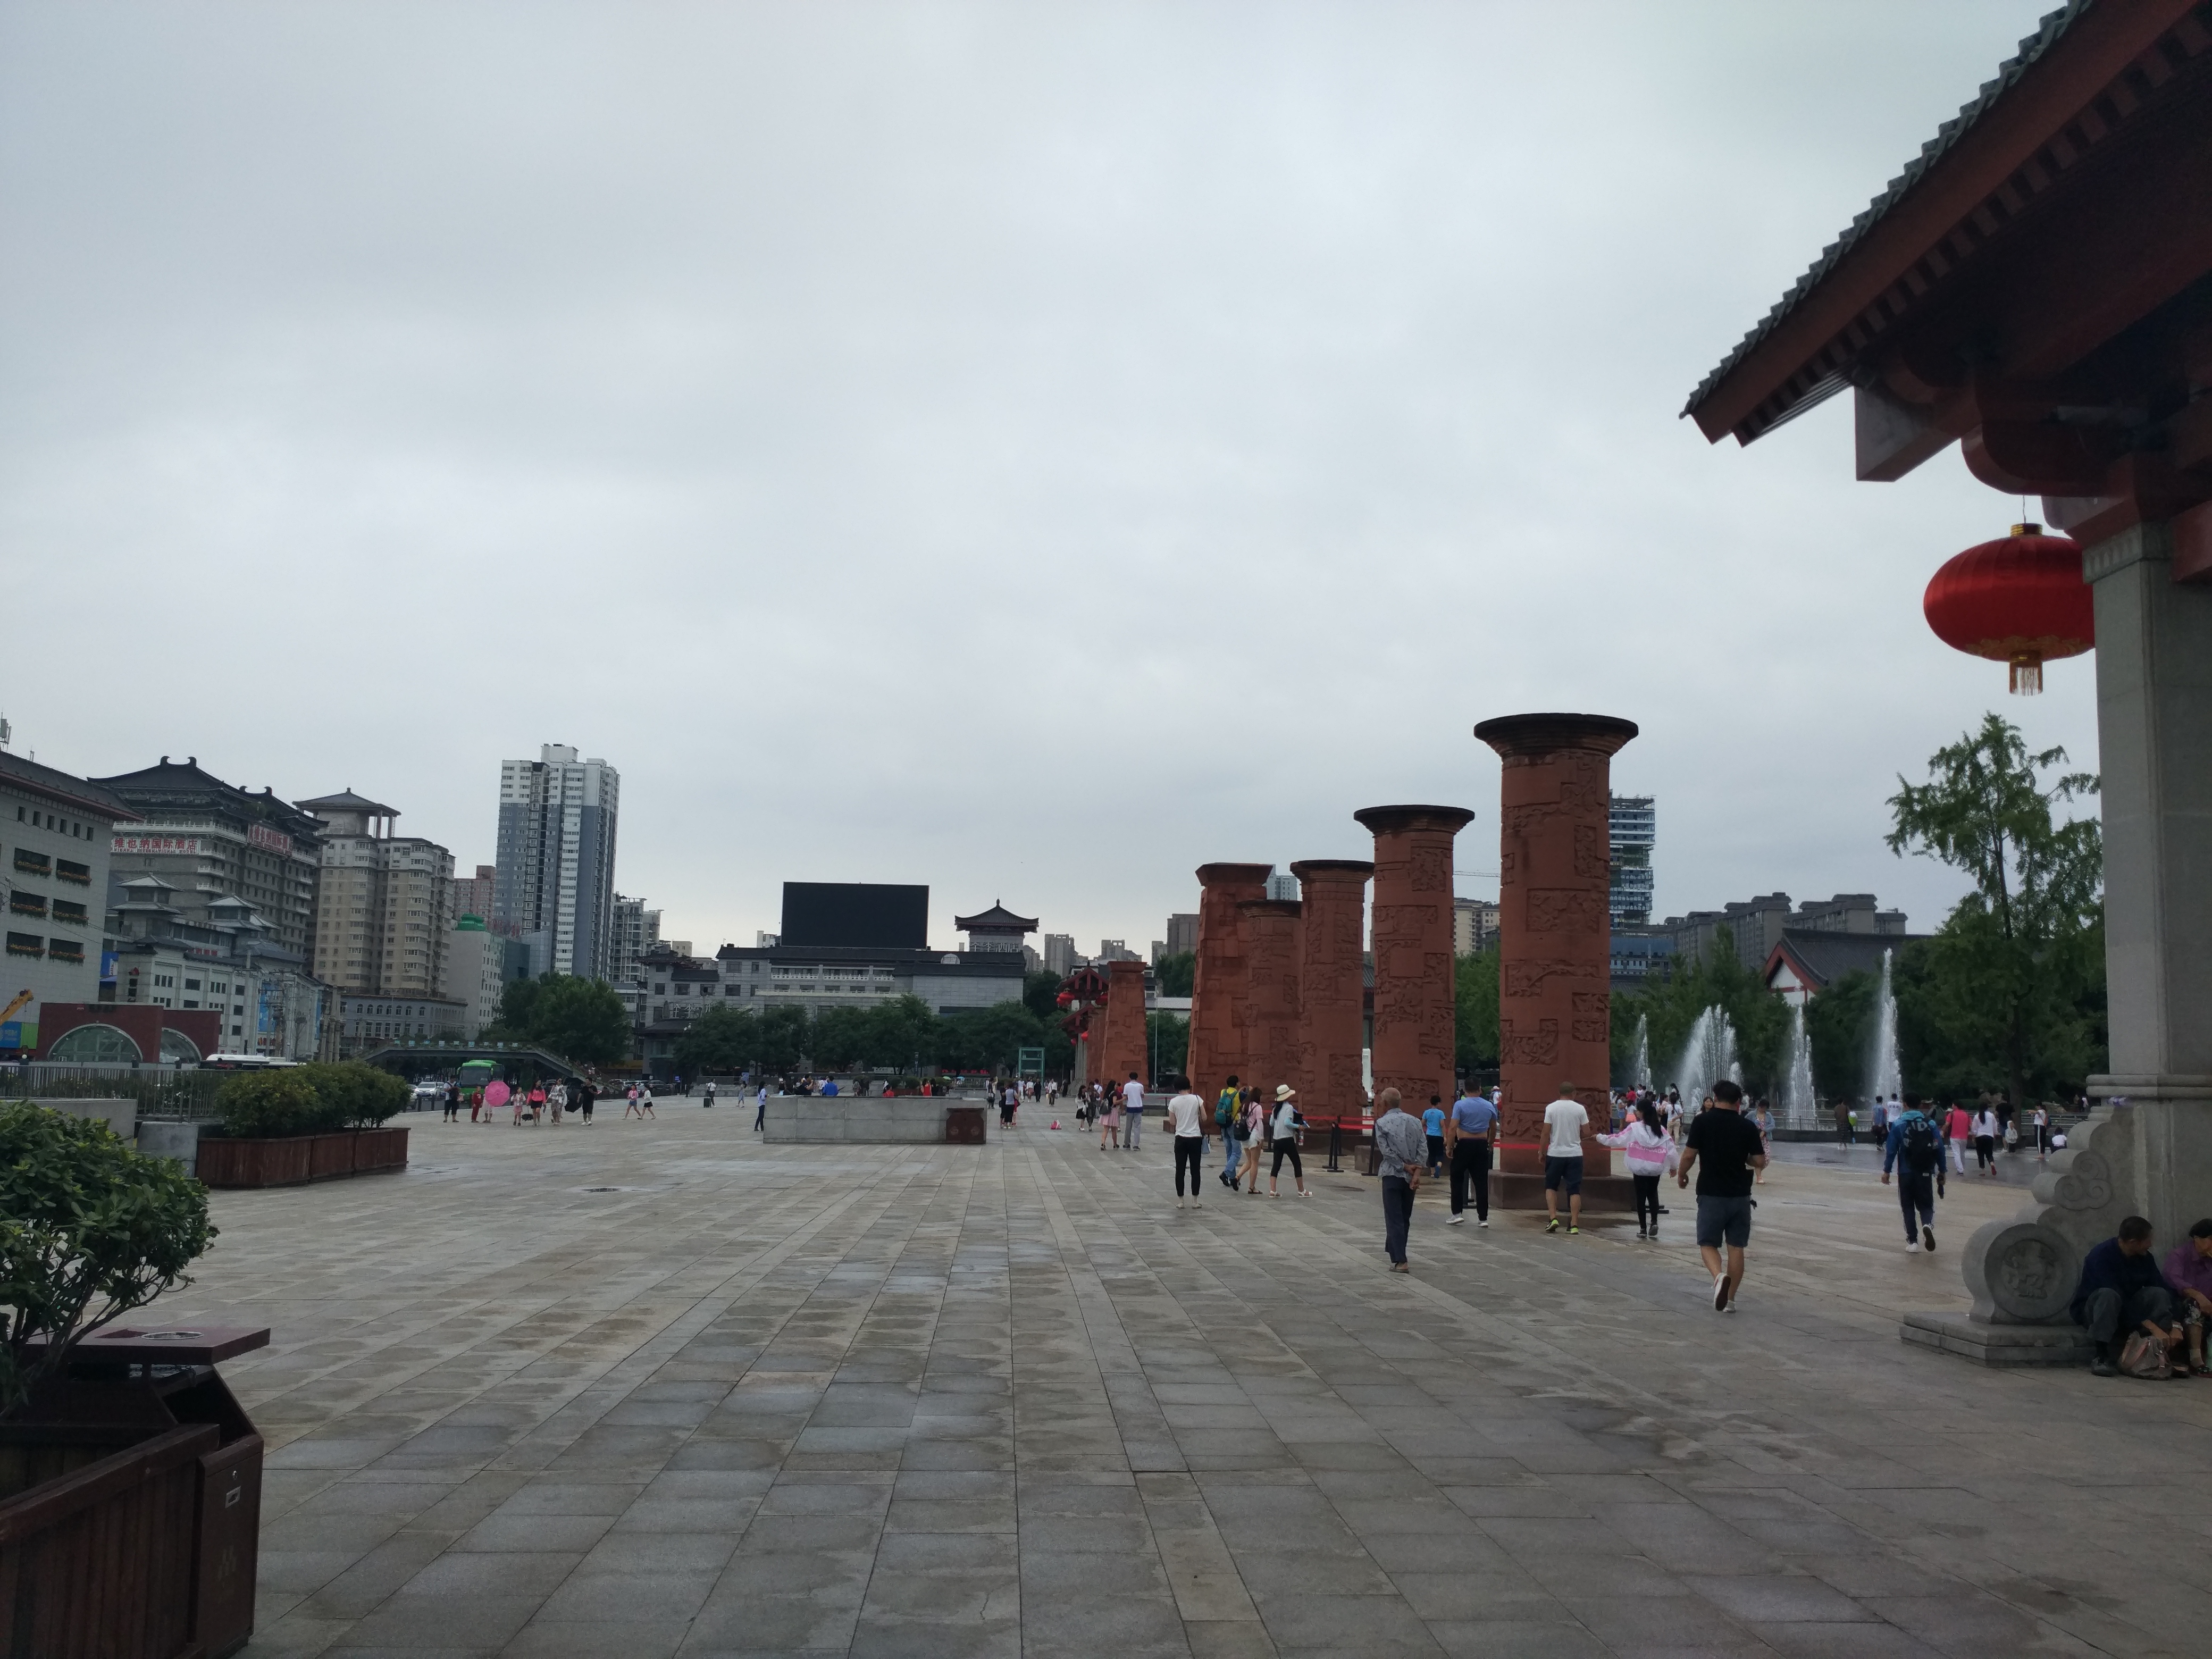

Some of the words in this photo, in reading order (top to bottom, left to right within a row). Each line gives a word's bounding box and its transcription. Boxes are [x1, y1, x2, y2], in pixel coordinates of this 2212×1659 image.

[114, 837, 197, 850] 维也纳国际酒店
[970, 942, 1019, 952] 全季酒店
